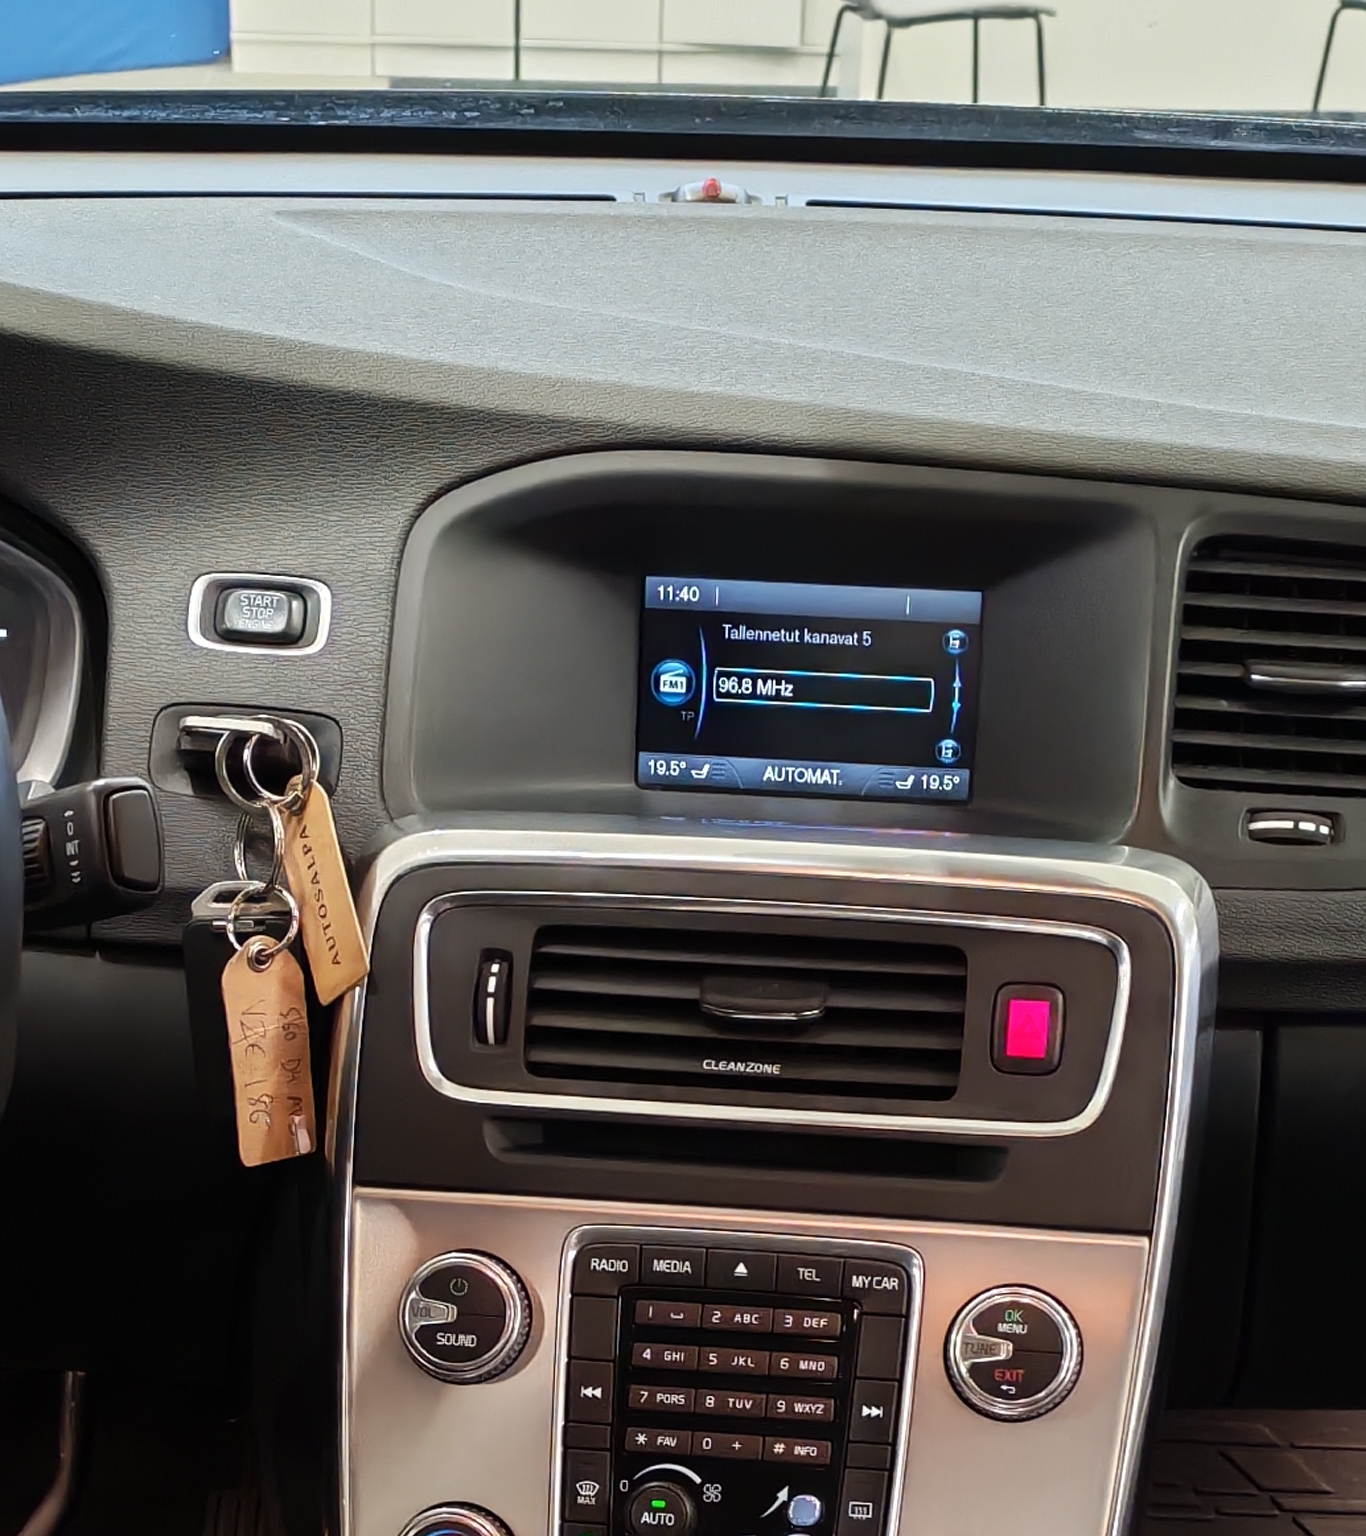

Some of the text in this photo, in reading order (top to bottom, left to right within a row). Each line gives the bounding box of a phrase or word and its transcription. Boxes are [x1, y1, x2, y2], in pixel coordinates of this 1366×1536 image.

[240, 594, 280, 607] START
[657, 585, 700, 602] 11:40
[243, 606, 274, 619] STOP
[722, 623, 873, 647] Tallennetut kanavat 5
[662, 678, 686, 692] FM1
[718, 677, 794, 697] 96.8 MHz
[648, 758, 686, 777] 19.5°
[762, 765, 843, 786] AUTOMAT.
[920, 774, 960, 791] 19.5°
[298, 823, 342, 966] AUTOSALPA
[702, 1057, 781, 1075] CLEANZONE
[590, 1258, 629, 1272] RADIO
[652, 1259, 692, 1274] MEDIA
[797, 1268, 821, 1282] TEL
[851, 1275, 899, 1290] MY CAR
[411, 1305, 434, 1318] VOL
[712, 1311, 761, 1325] 2 ABC
[1004, 1309, 1024, 1323] OK
[783, 1315, 828, 1329] 3 DEF
[997, 1322, 1028, 1334] MENU
[436, 1332, 477, 1347] SOUND
[642, 1348, 685, 1363] 4 GHI
[963, 1342, 997, 1356] TUNE
[708, 1353, 755, 1368] 5 JKL
[780, 1357, 825, 1372] 6 MNO
[994, 1368, 1025, 1382] EXIT
[639, 1391, 649, 1404] 7
[705, 1395, 753, 1410] 8 TUV
[776, 1400, 825, 1415] 9 WXYZ
[656, 1435, 677, 1448] FAV
[794, 1445, 817, 1457] INFO
[576, 1496, 596, 1505] MAX
[640, 1511, 675, 1526] AUTO
